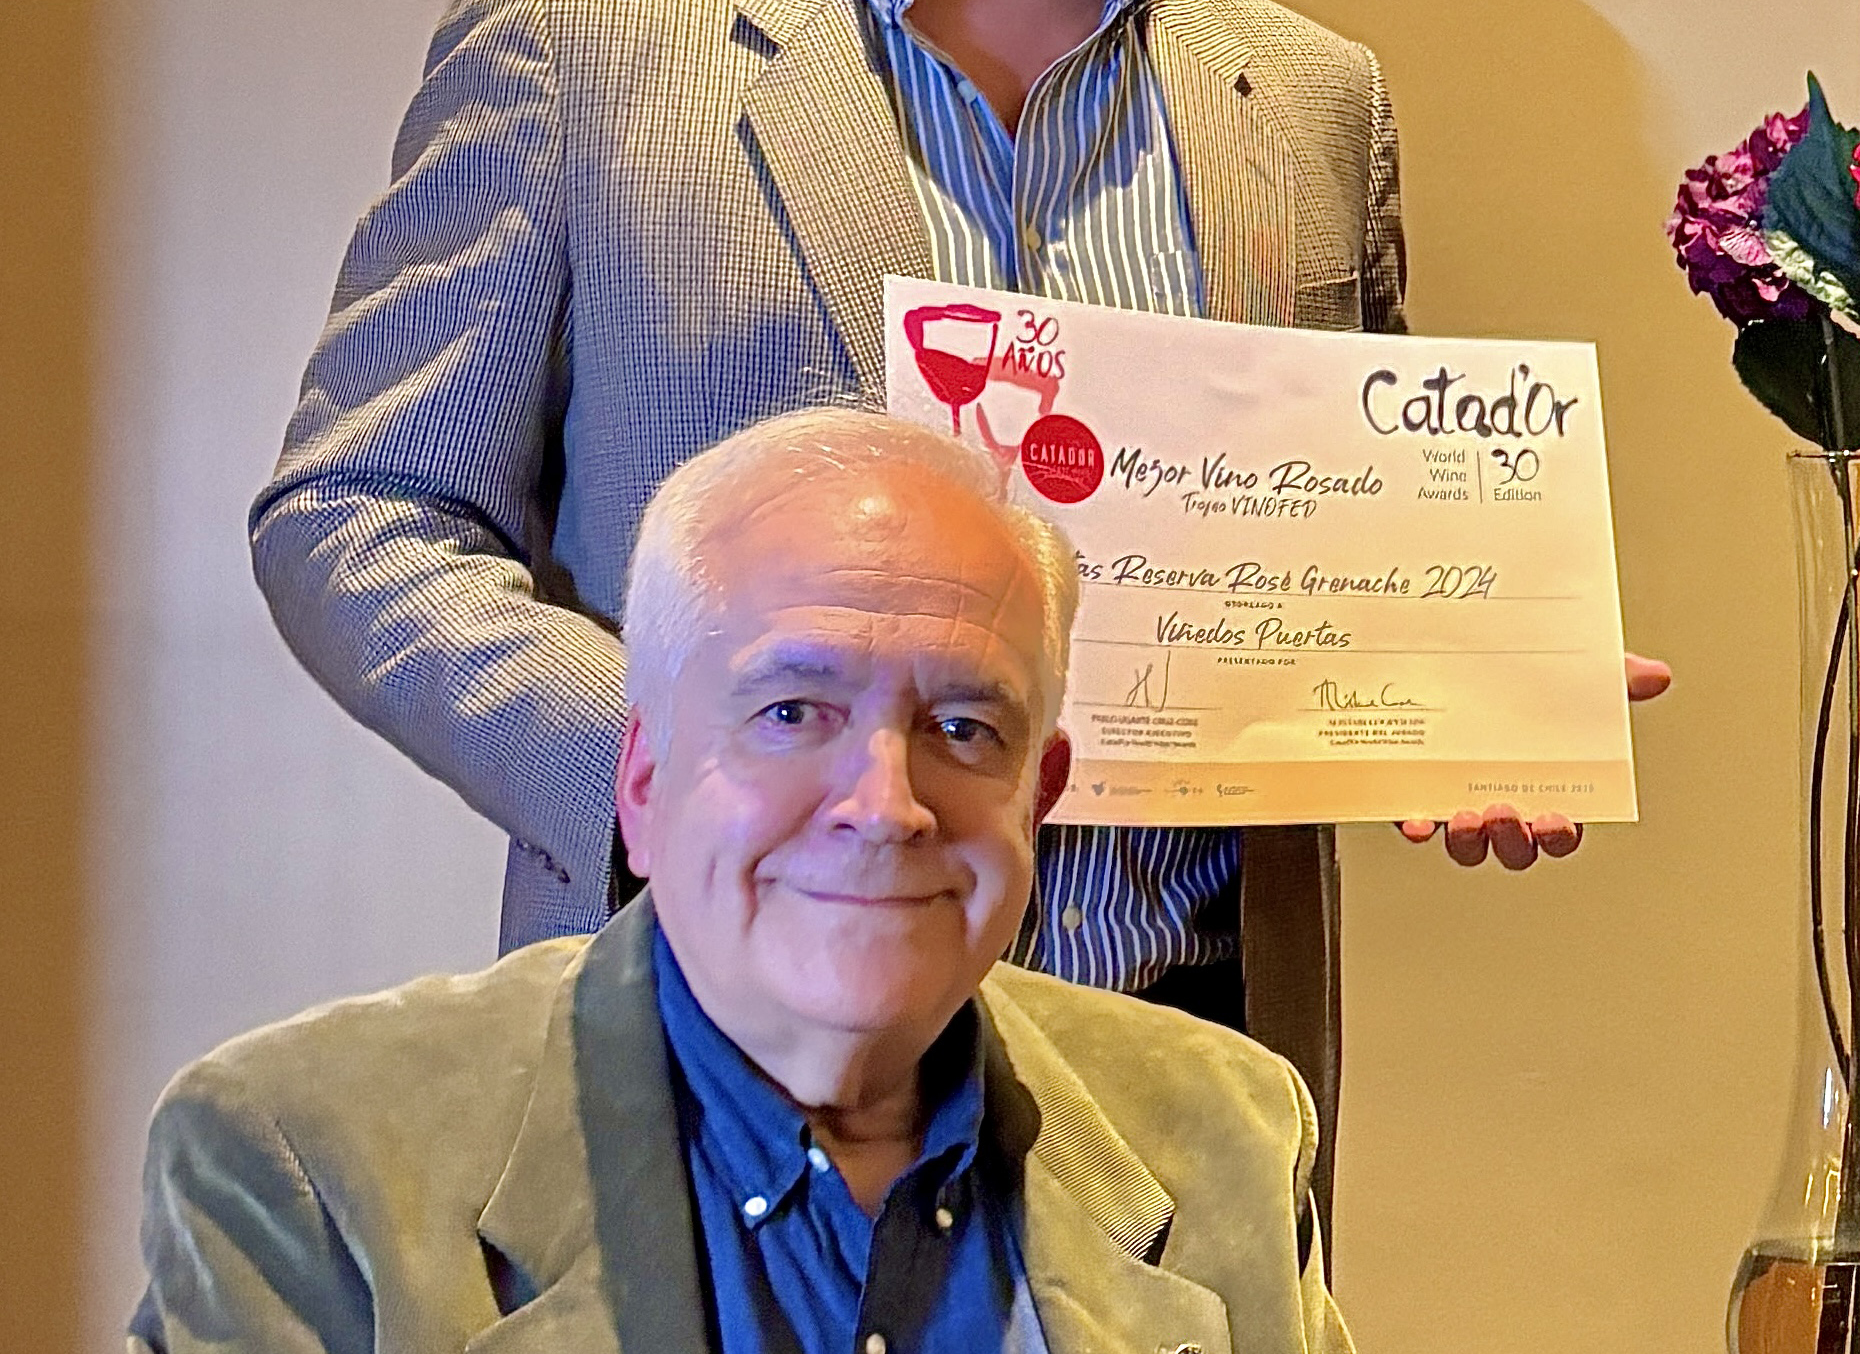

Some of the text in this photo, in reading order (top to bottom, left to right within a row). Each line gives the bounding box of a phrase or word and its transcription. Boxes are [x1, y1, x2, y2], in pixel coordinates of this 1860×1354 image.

[1016, 309, 1059, 346] 30
[1362, 363, 1579, 438] Catad'Or
[1110, 447, 1384, 498] Mejor Vino Rosado
[1422, 448, 1466, 464] World
[1491, 448, 1540, 485] 30
[1417, 486, 1469, 501] Awards
[1430, 468, 1468, 483] Wine
[1231, 495, 1317, 519] VINOFED
[1493, 487, 1542, 502] Edition
[1111, 554, 1220, 587] Reserva
[1225, 562, 1291, 594] Rosé
[1300, 564, 1410, 596] Grenache
[1419, 565, 1498, 599] 2024
[1157, 611, 1352, 650] Viñedos Puertas
